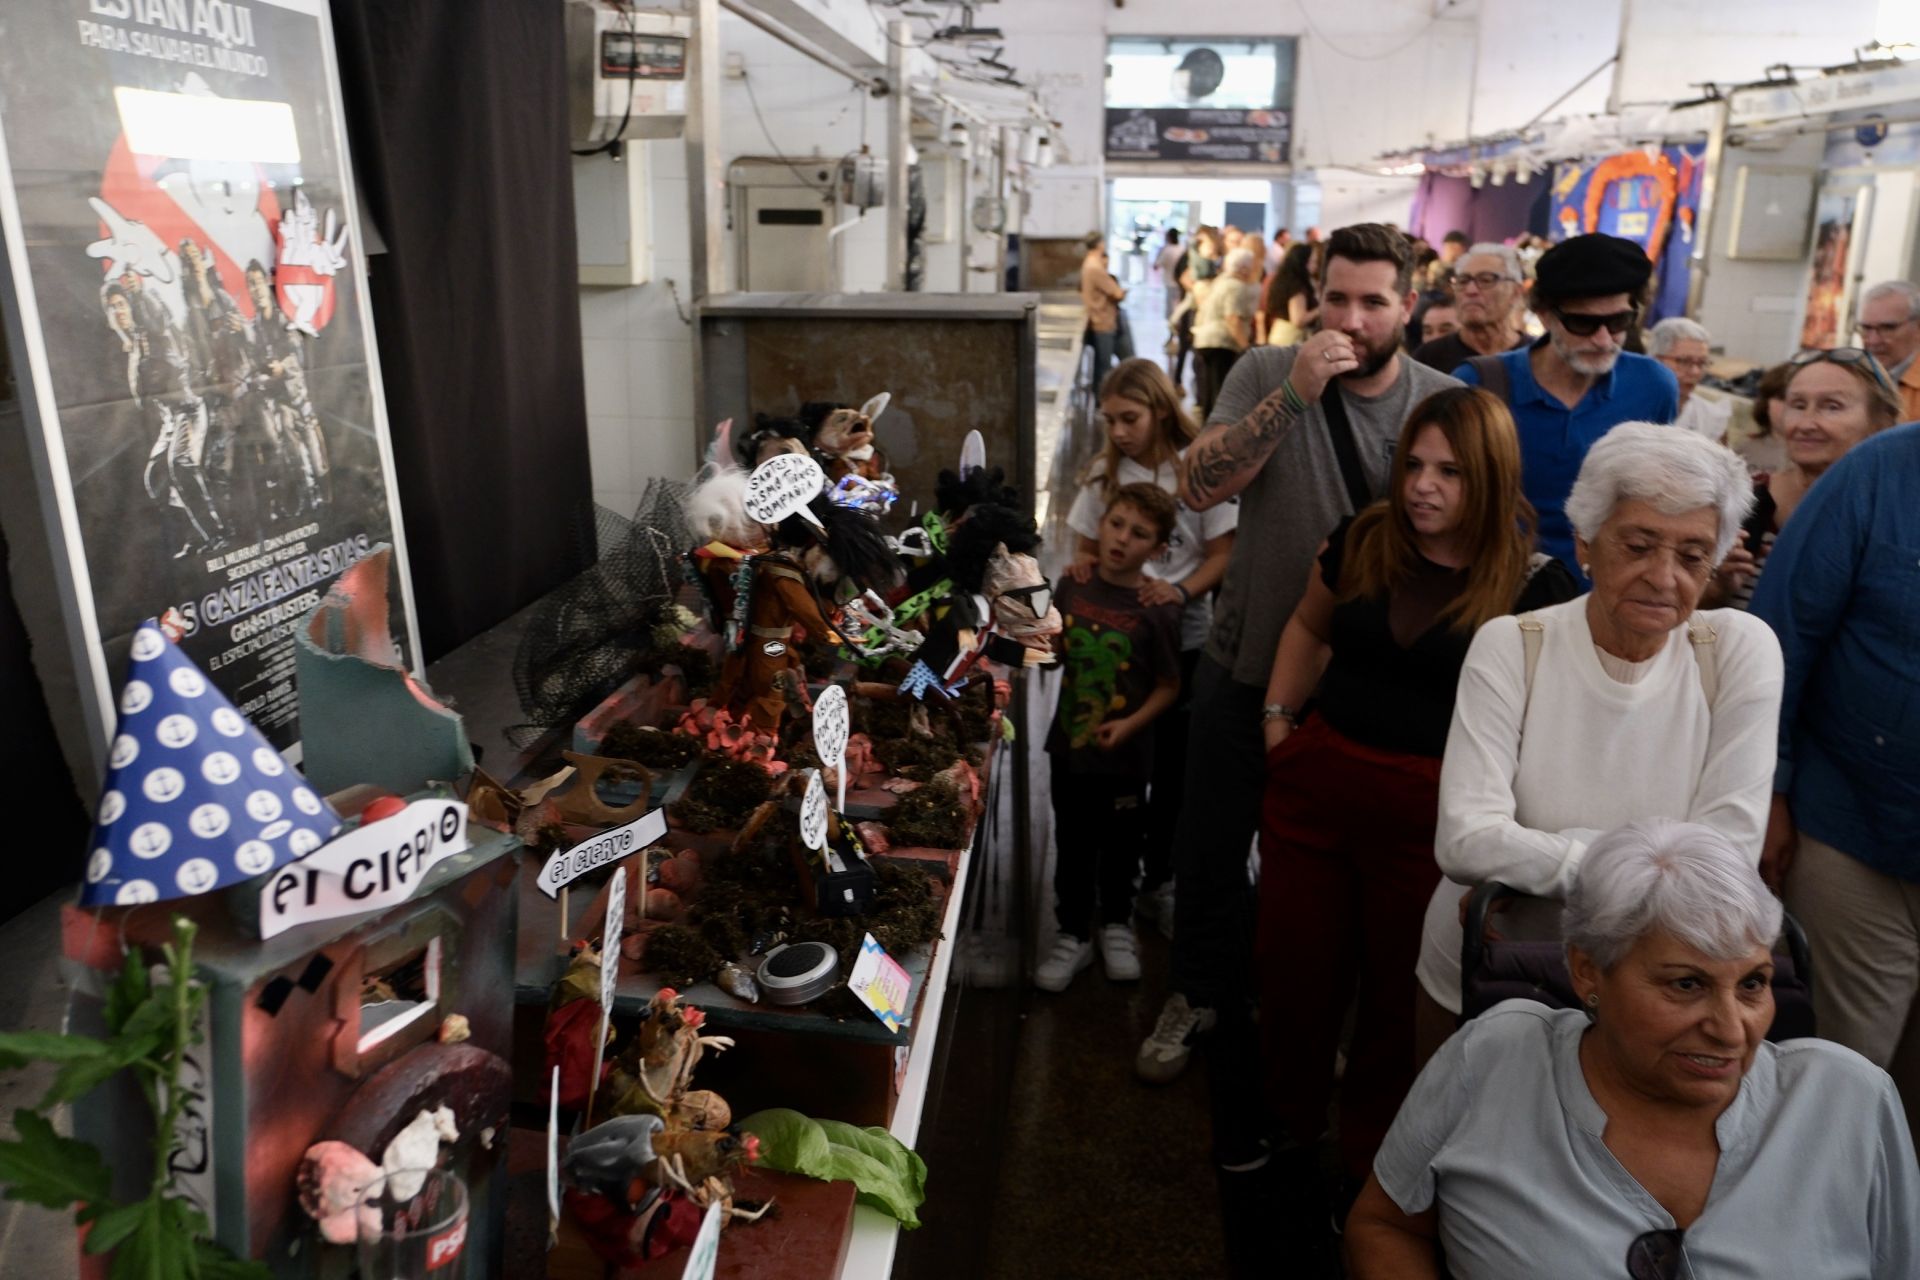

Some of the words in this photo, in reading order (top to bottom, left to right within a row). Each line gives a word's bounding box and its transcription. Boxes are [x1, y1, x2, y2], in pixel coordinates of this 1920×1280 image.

[77, 20, 131, 53] PARA
[129, 31, 193, 63] SALVAR
[191, 43, 216, 68] EL
[213, 47, 268, 77] MUNDO
[201, 534, 369, 627] CAZAFANTASMAS
